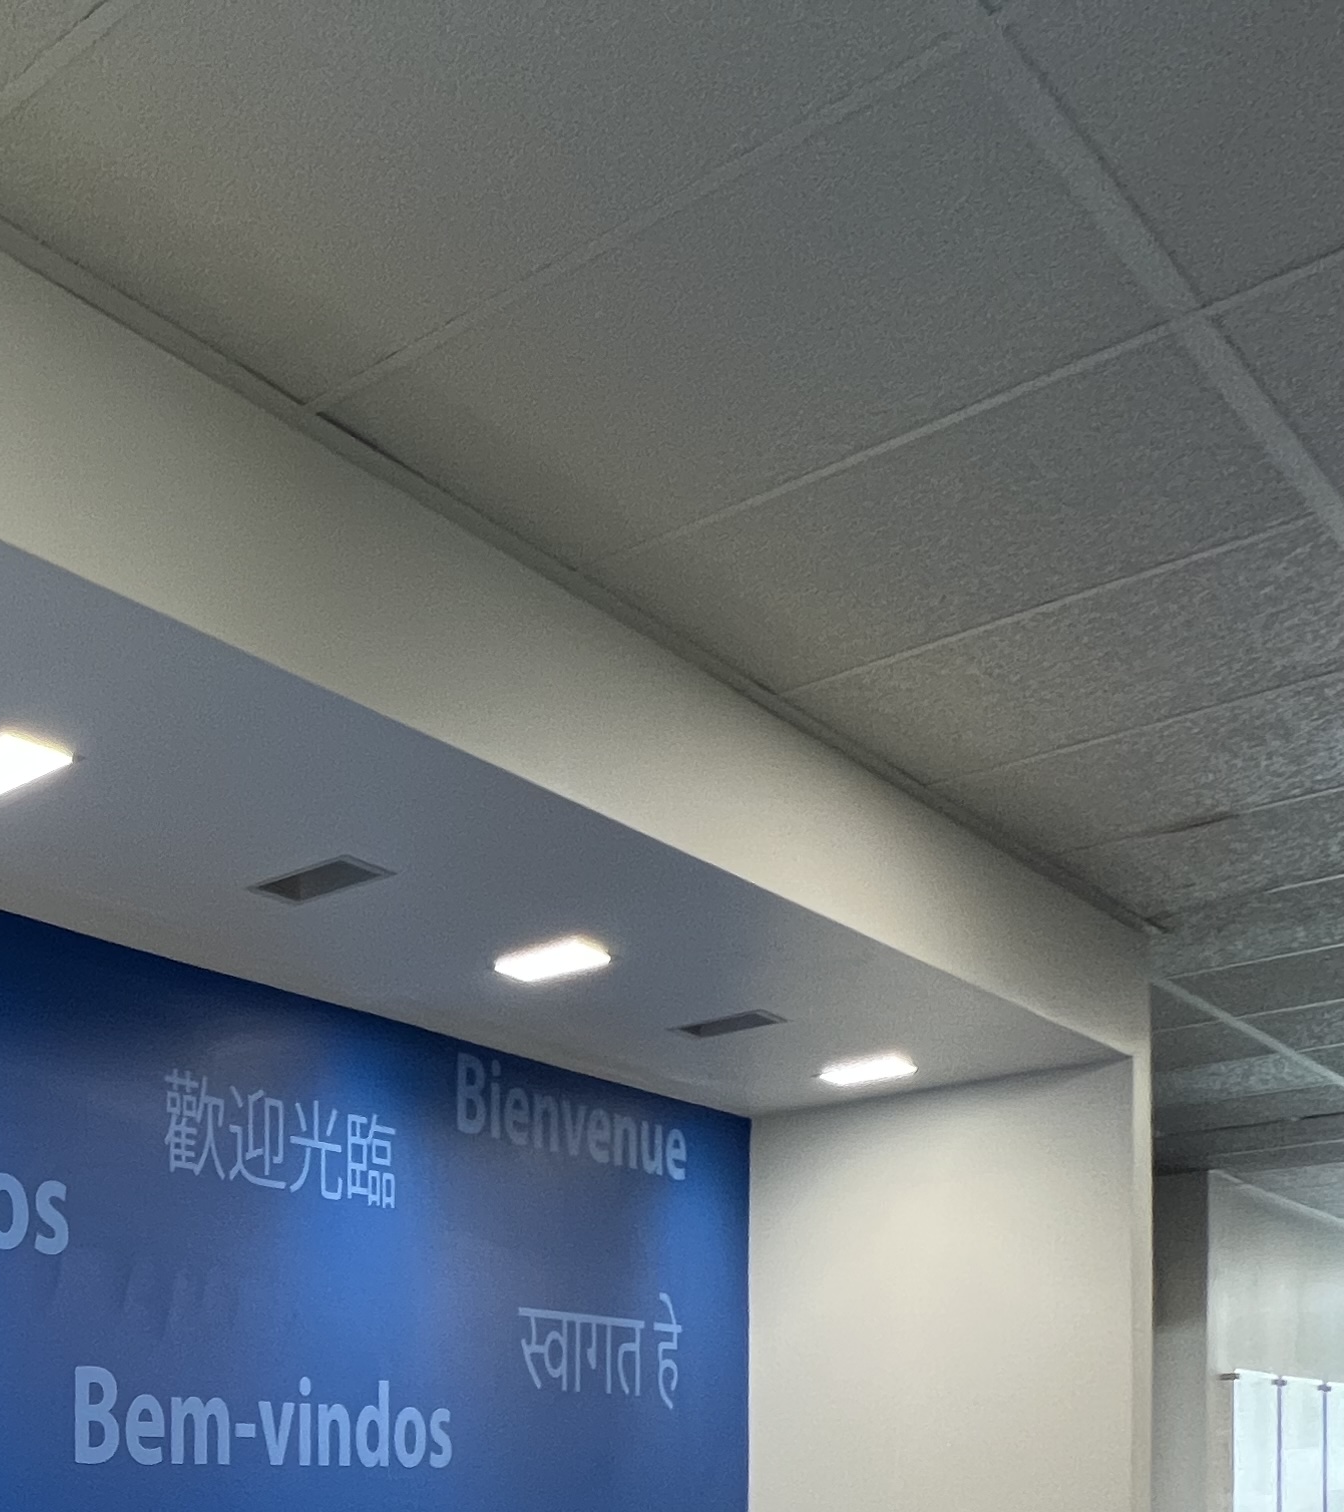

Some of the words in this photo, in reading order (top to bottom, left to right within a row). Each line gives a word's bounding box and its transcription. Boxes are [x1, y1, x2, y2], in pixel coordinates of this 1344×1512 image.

[164, 1068, 396, 1208] 歡迎光臨
[457, 1052, 687, 1181] Bienvenue
[518, 1307, 645, 1396] स्वागत
[74, 1366, 452, 1467] Bem-vindos
